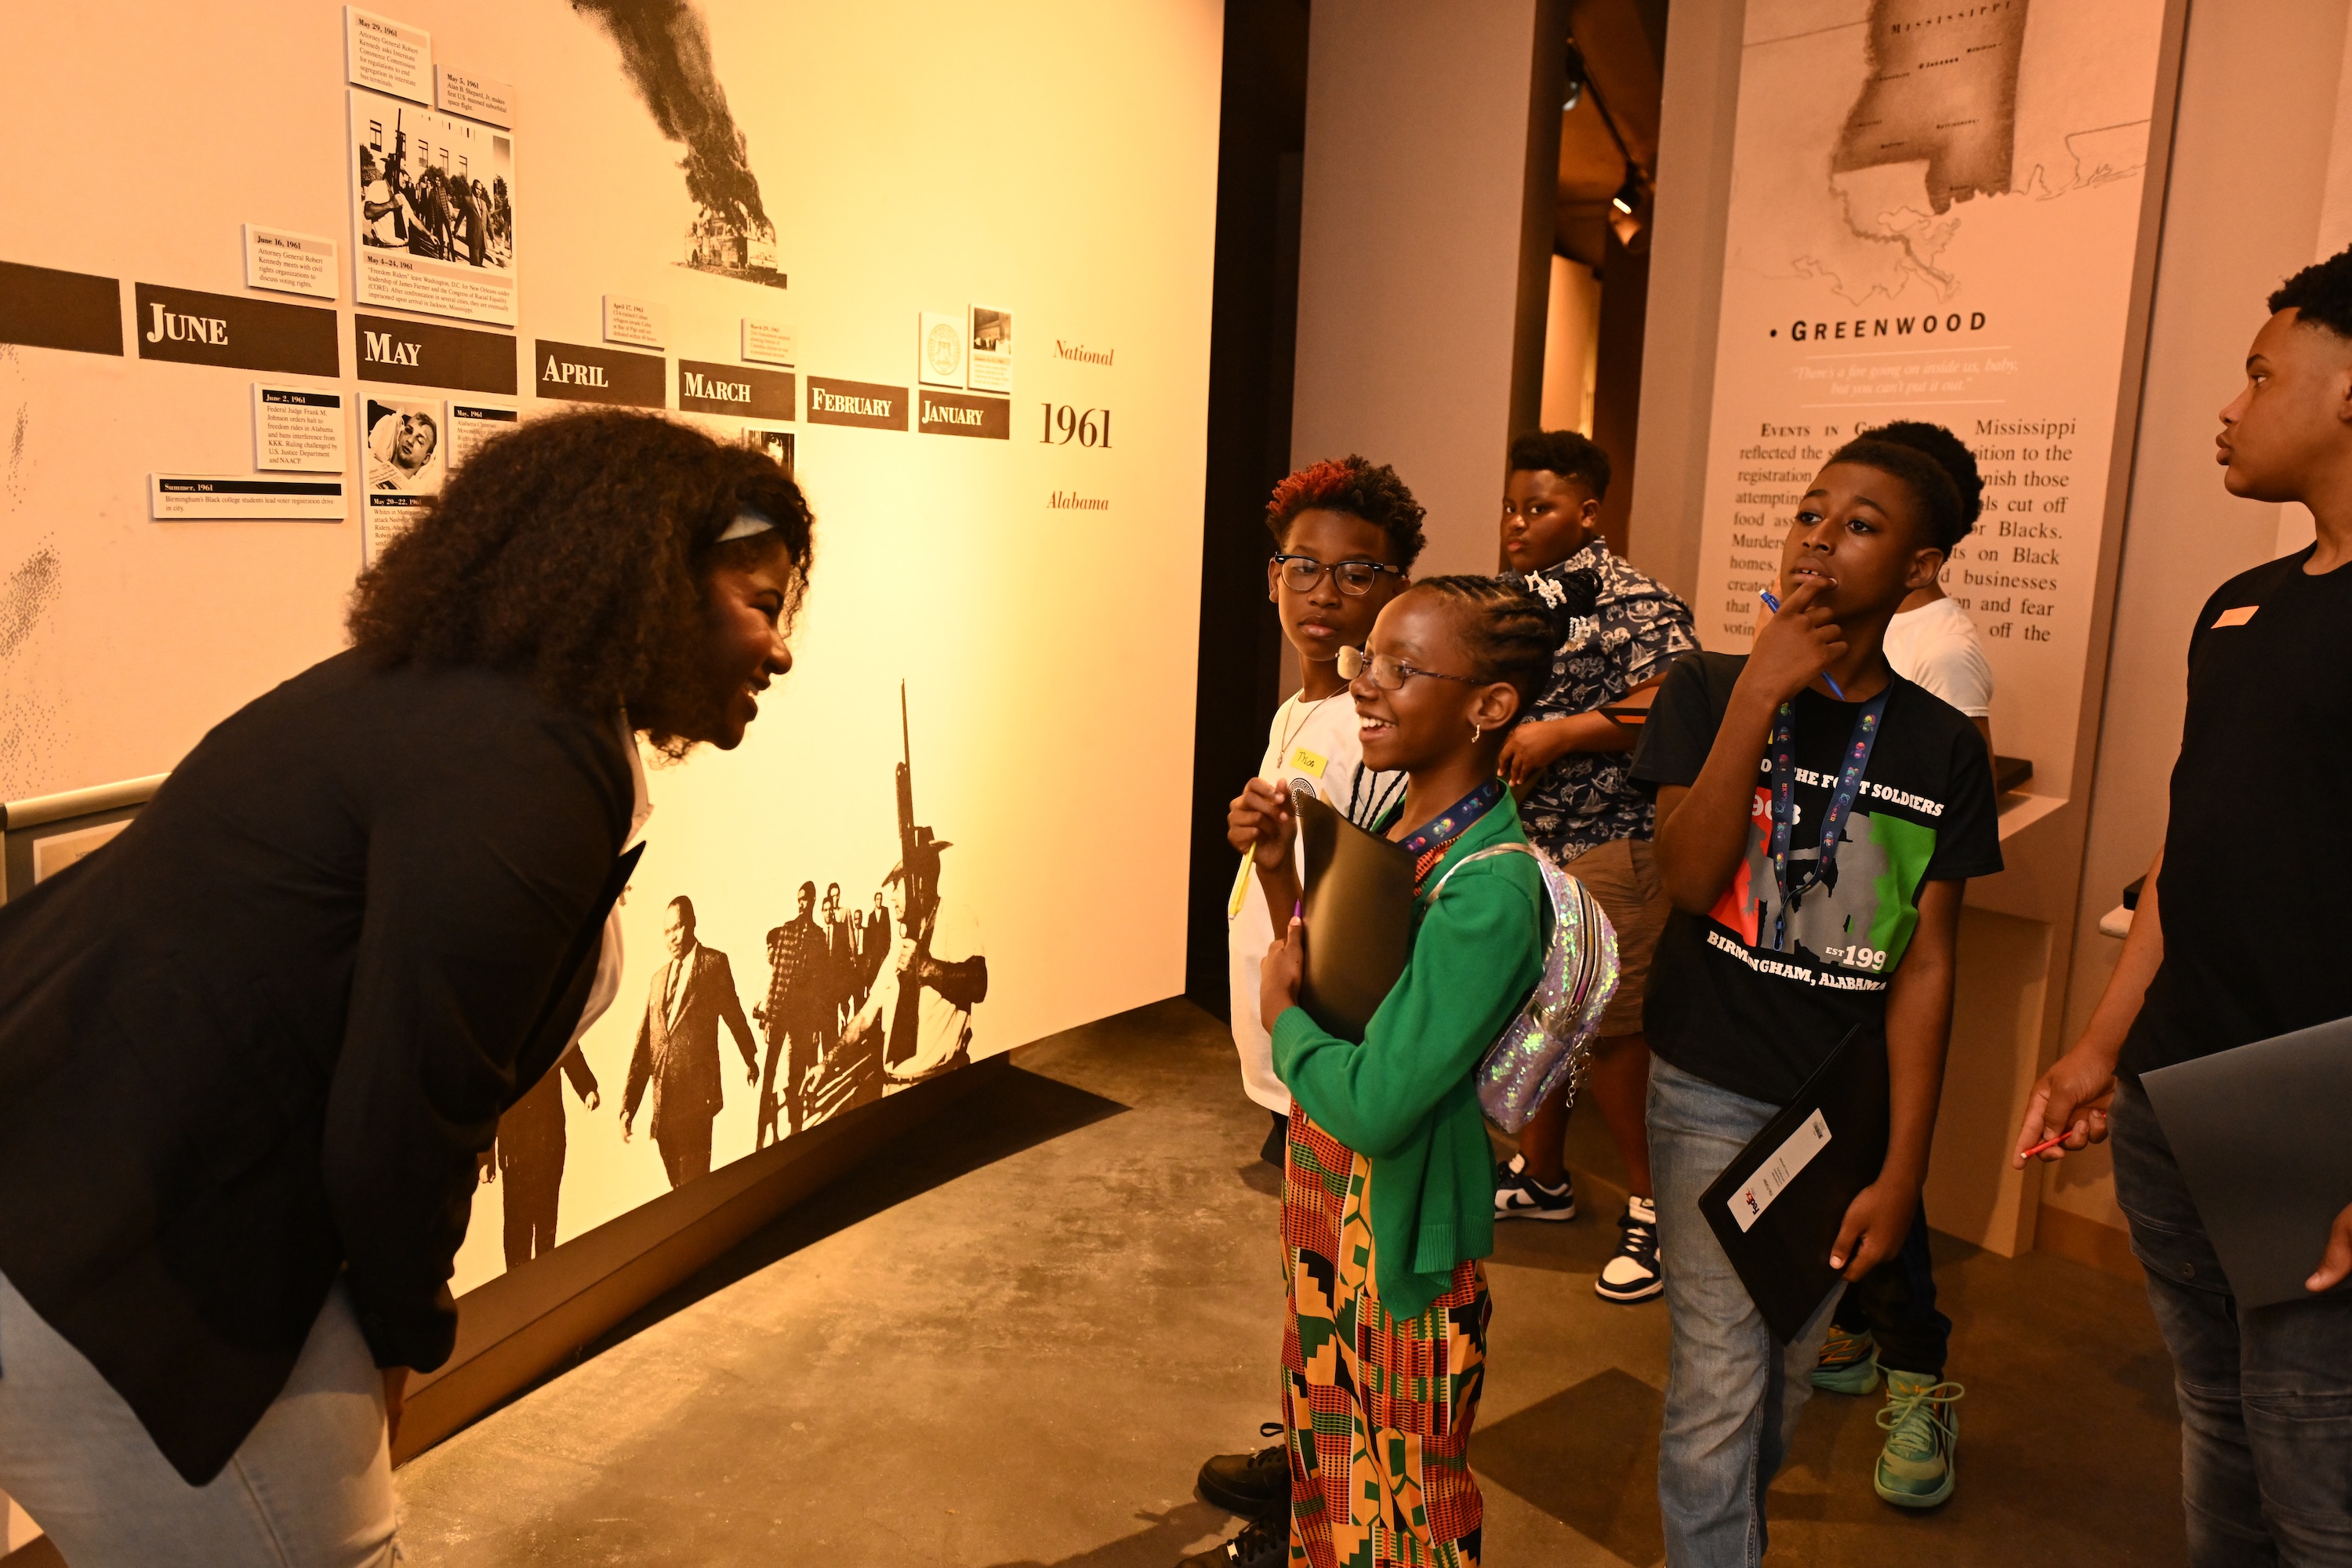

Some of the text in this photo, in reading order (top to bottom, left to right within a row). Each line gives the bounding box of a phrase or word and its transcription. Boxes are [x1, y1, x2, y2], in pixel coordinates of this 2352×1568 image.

[359, 19, 397, 37] May 29, 1961
[359, 31, 418, 54] Attorney General Robert
[359, 39, 380, 51] Kennedy
[394, 49, 415, 61] Interstate
[360, 48, 416, 70] Commerce Commission
[368, 60, 394, 72] regulations
[360, 66, 387, 78] segregation
[394, 74, 416, 86] interstate
[369, 75, 393, 87] terminals.
[447, 74, 458, 84] May
[466, 80, 479, 89] 1961
[448, 99, 474, 111] space flight.
[466, 88, 484, 100] Shepard,
[492, 95, 505, 104] makes
[486, 101, 506, 113] suborbital
[275, 238, 285, 247] 16,
[287, 241, 301, 249] 1961
[259, 249, 281, 258] Attorney
[305, 256, 323, 264] Robert
[259, 256, 281, 267] Kennedy
[368, 256, 379, 264] May
[380, 259, 398, 267] 4–24,
[275, 269, 309, 279] organizations
[1791, 311, 1987, 341] GREENWOOD
[1053, 339, 1114, 366] National
[1040, 403, 1112, 448] 1961
[1975, 418, 2076, 439] Mississippi
[1740, 445, 1796, 459] reflected
[1802, 445, 1823, 459] the
[2023, 448, 2038, 460] to
[2045, 445, 2072, 461] the
[1737, 467, 2069, 487] registration those
[165, 495, 204, 504] Birmingham's
[1047, 490, 1109, 510] Alabama
[2008, 499, 2033, 512] cut
[2043, 496, 2068, 513] off
[1733, 511, 1765, 526] food
[1999, 521, 2062, 539] Blacks.
[1979, 550, 1998, 561] on
[2013, 546, 2060, 564] Black
[1730, 555, 1777, 572] homes,
[1964, 569, 2057, 590] businesses
[1980, 597, 2011, 612] and
[2021, 598, 2054, 616] fear
[1726, 599, 1750, 613] that
[1990, 622, 2013, 637] off
[2024, 624, 2051, 641] the
[1871, 782, 1945, 818] SOLDIERS
[1825, 947, 1844, 957] EST
[1745, 1190, 1760, 1215] FedEx
